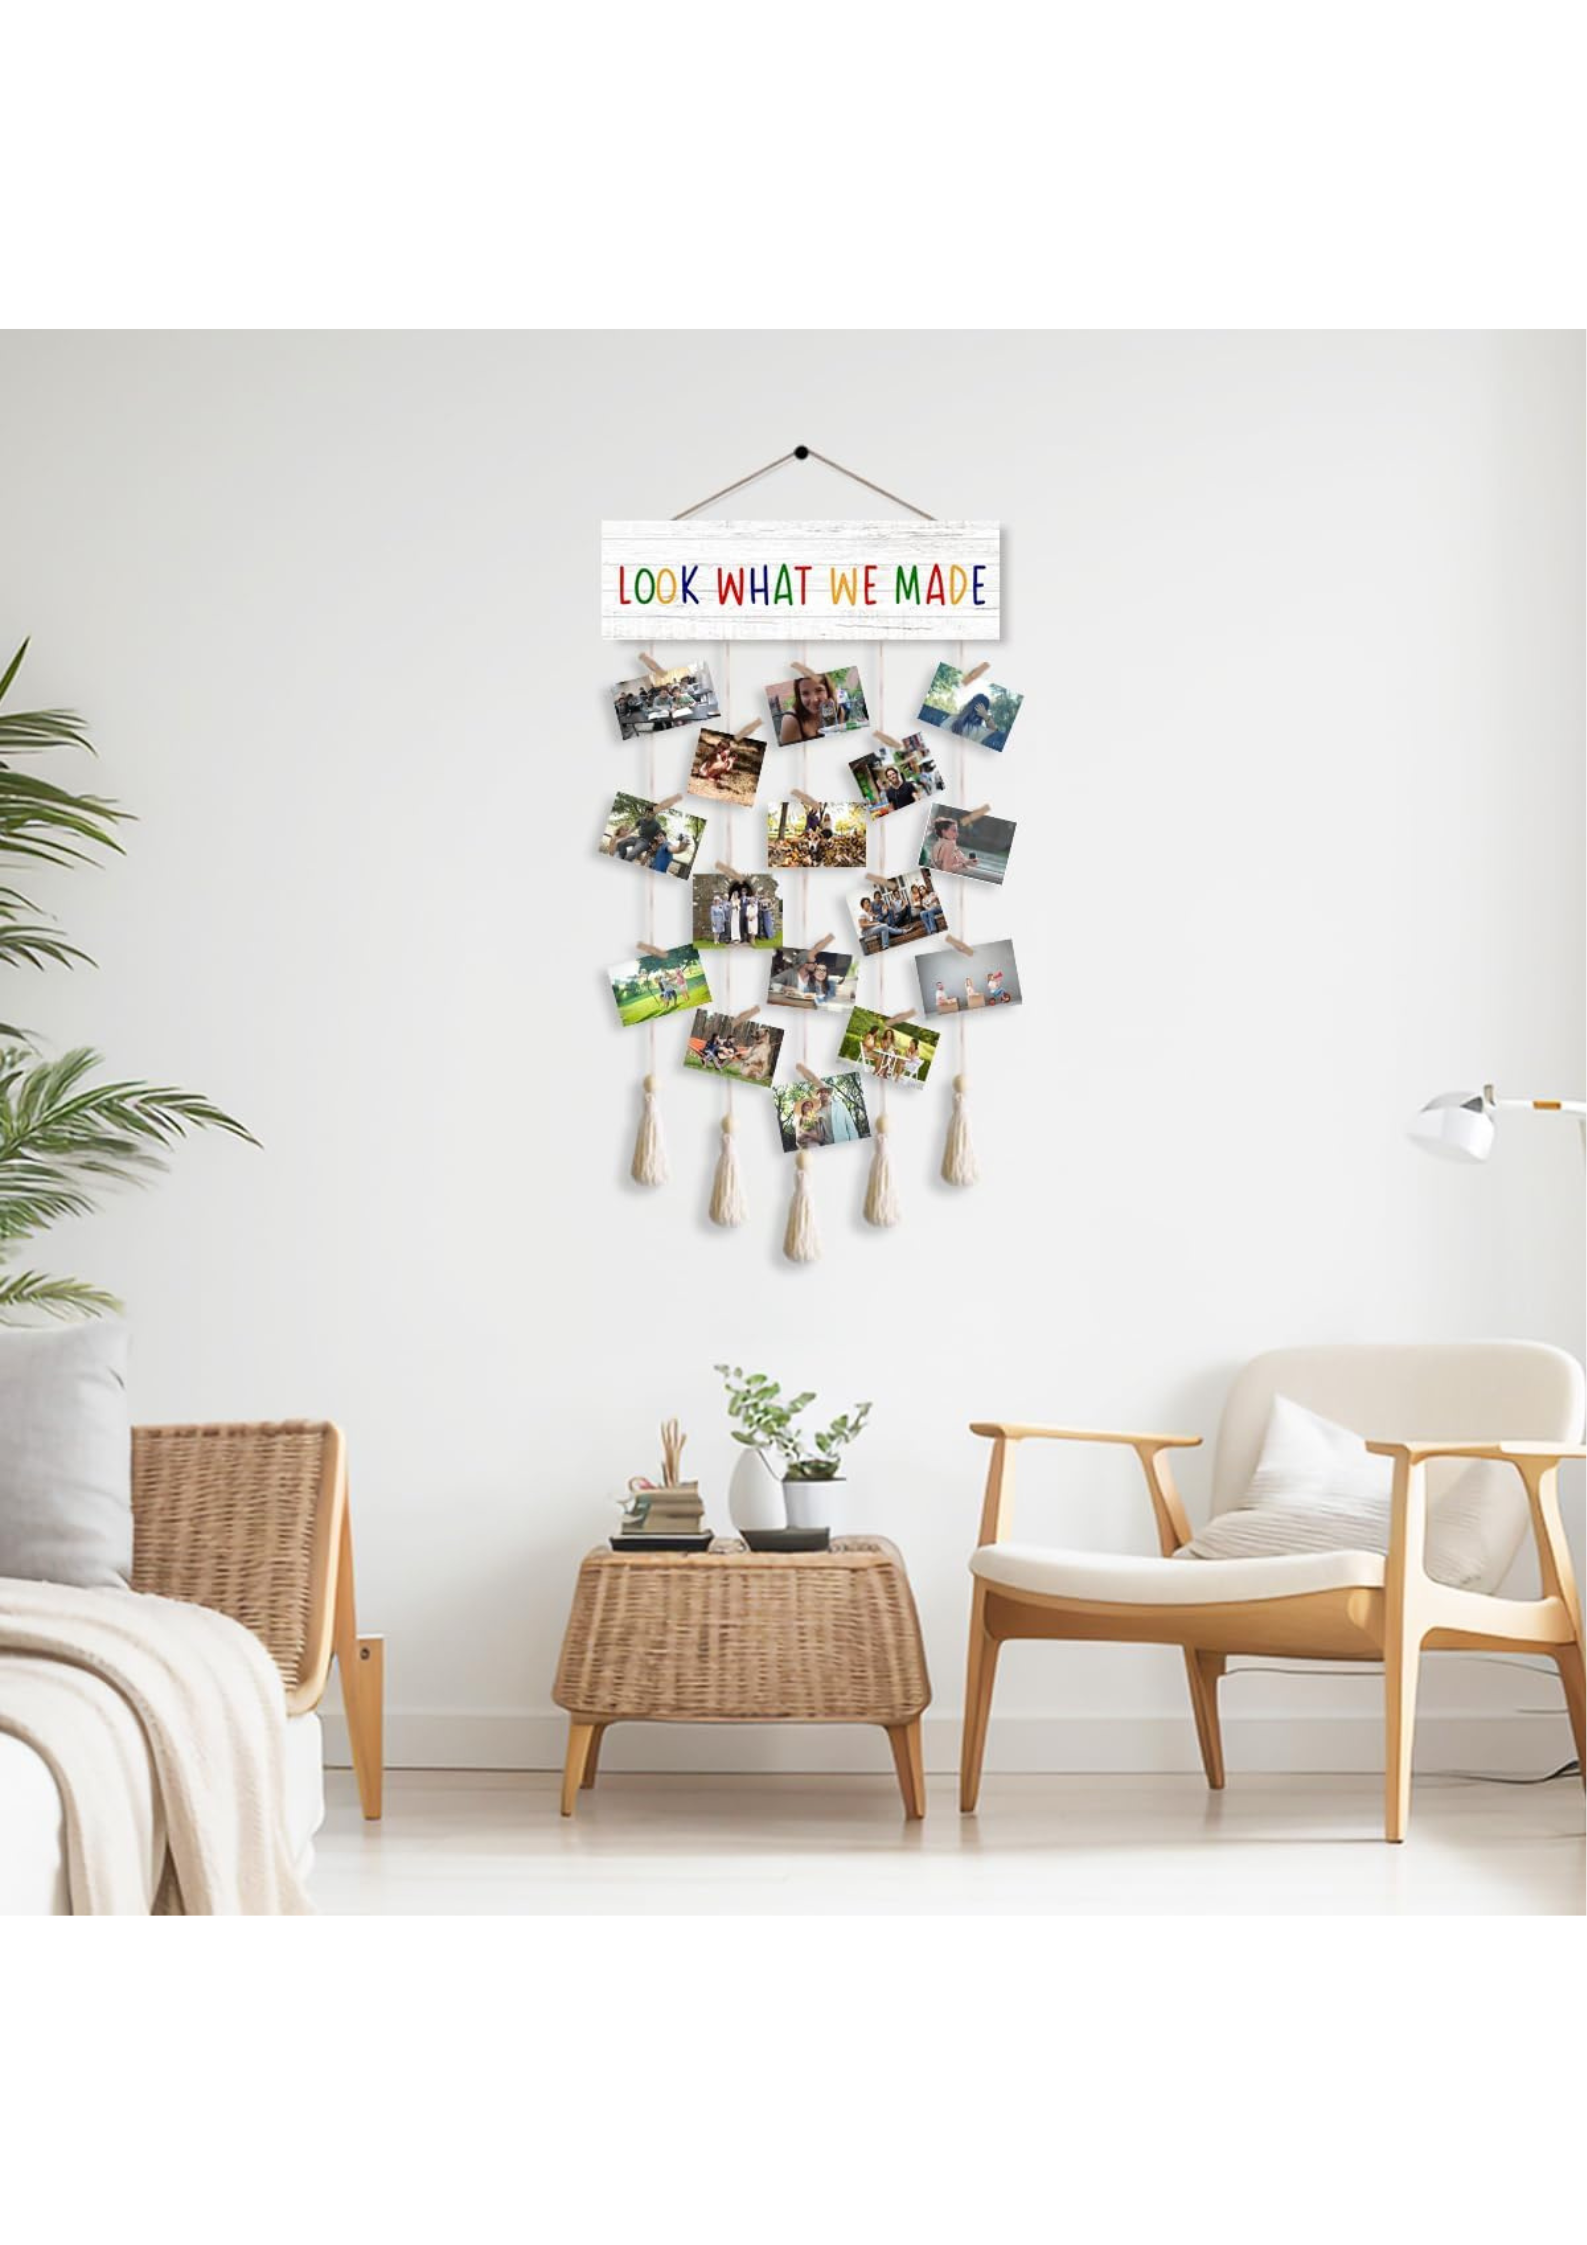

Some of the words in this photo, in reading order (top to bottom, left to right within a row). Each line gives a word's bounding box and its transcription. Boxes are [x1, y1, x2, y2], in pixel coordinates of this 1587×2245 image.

[619, 565, 699, 606] LOOK
[717, 563, 813, 606] WHAT
[830, 564, 878, 606] WE
[895, 563, 986, 606] MADE
